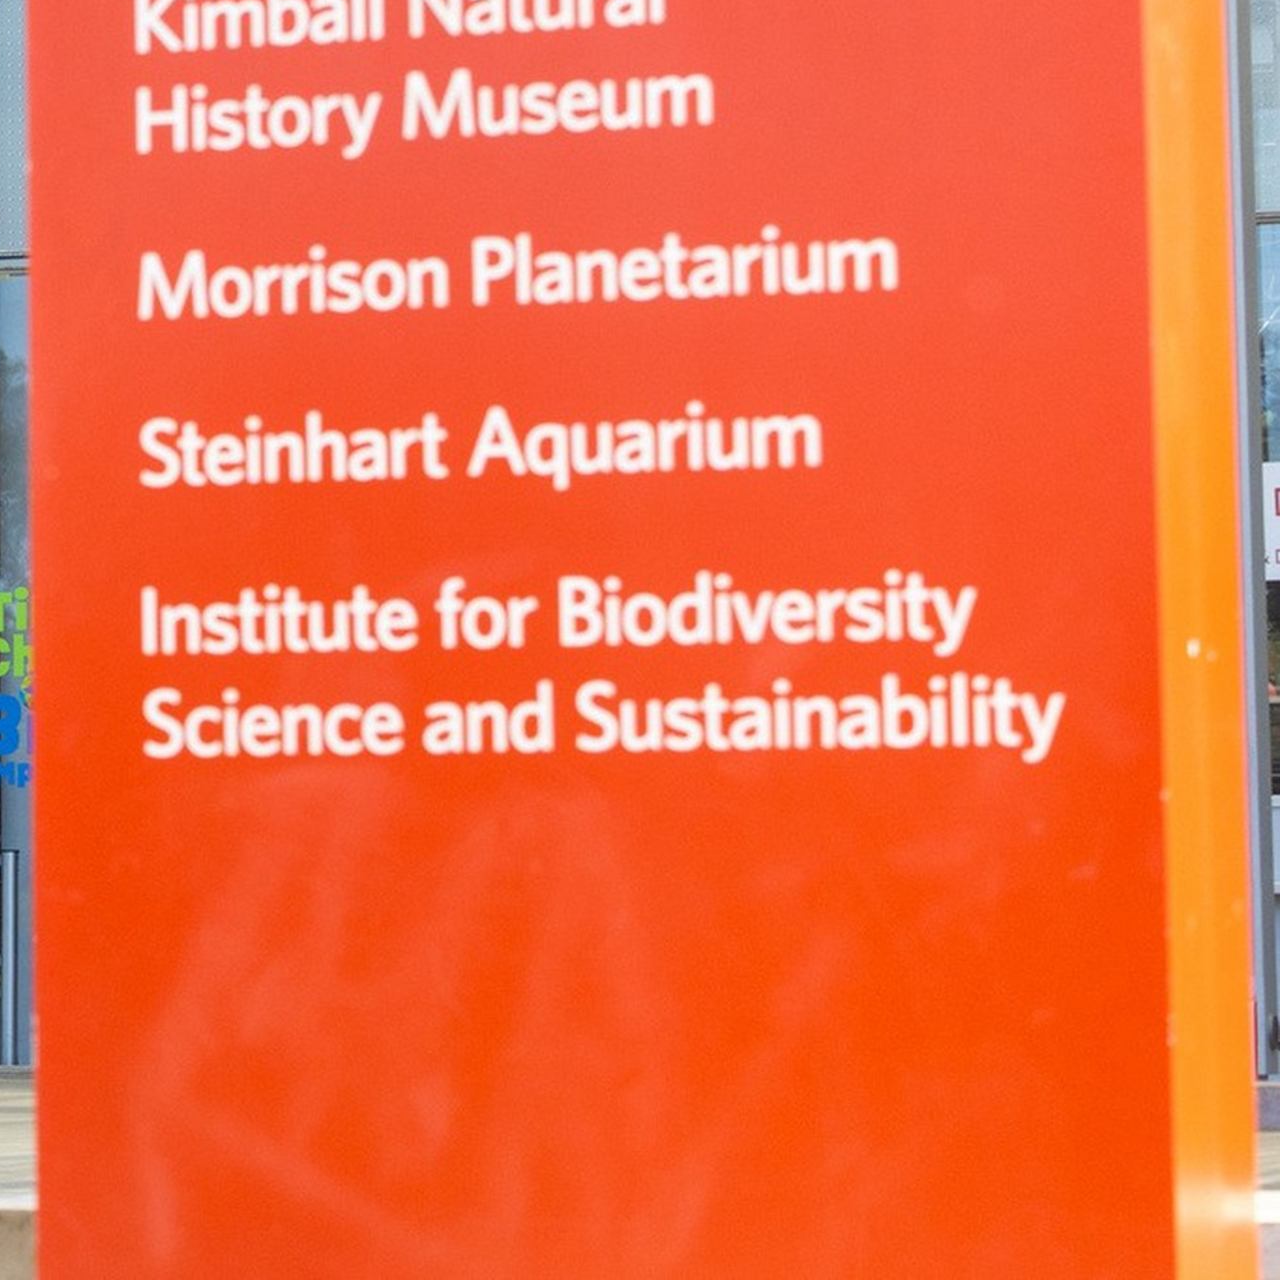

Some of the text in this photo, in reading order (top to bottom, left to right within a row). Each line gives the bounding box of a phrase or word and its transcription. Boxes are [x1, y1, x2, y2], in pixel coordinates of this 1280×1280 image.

[134, 67, 715, 161] History Museum
[136, 224, 899, 321] Morrison Planetarium
[138, 400, 823, 492] Steinhart Aquarium
[140, 569, 977, 658] Institute for Biodiversity
[143, 673, 1065, 765] Science and Sustainability
